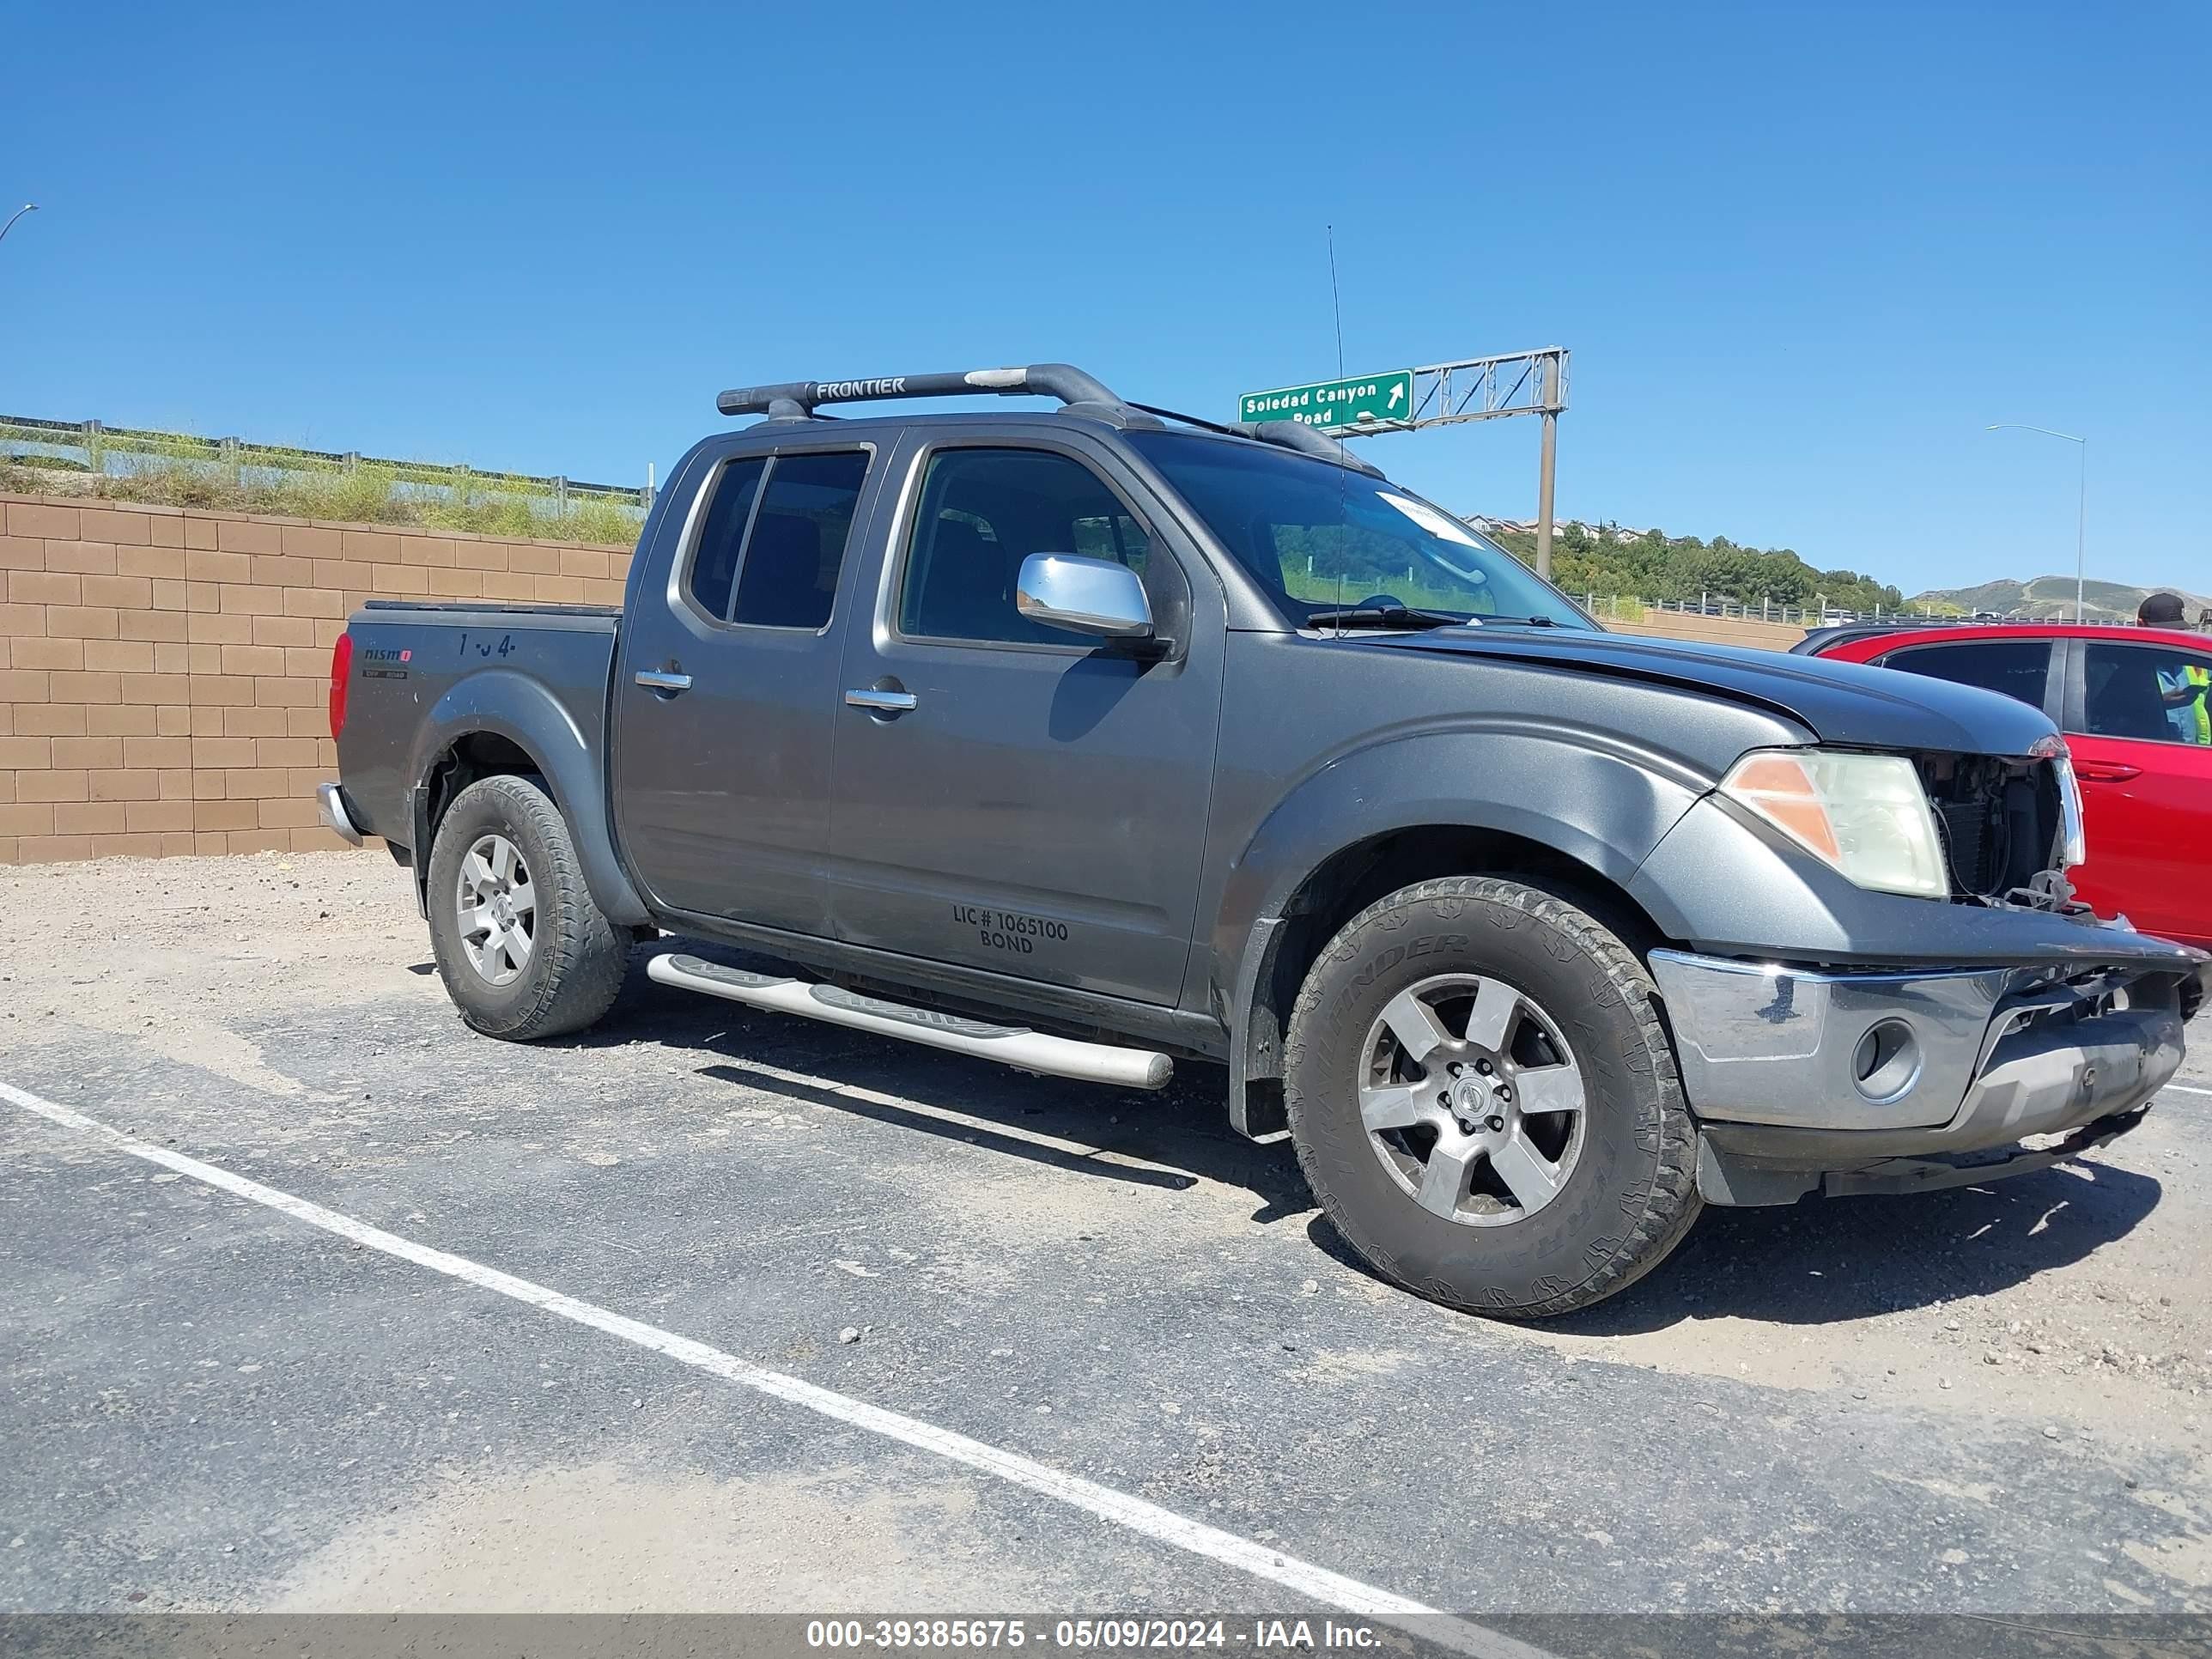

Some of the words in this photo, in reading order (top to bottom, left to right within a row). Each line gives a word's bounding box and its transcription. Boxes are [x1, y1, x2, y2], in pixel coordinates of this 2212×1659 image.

[817, 376, 906, 399] FRONTIER
[1246, 391, 1310, 413] Soledad
[1316, 384, 1376, 404] Canyon
[1293, 408, 1332, 426] Road
[953, 905, 977, 925] LIC
[997, 913, 1069, 941] 1065100
[981, 930, 1034, 954] BOND
